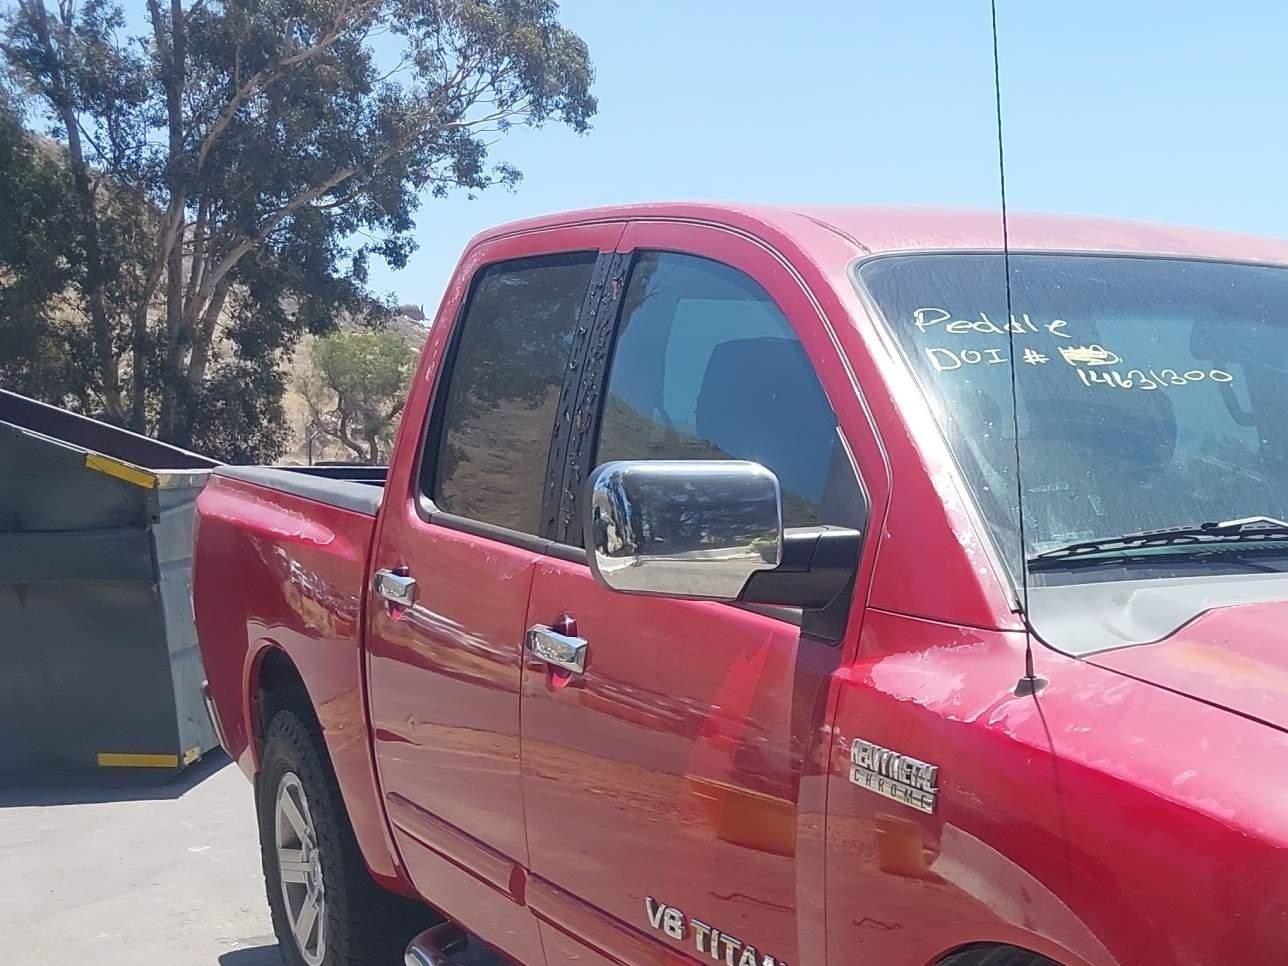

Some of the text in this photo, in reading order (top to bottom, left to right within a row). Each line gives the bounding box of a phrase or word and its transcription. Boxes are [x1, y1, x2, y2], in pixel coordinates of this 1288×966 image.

[913, 307, 1072, 338] Peddle
[925, 346, 1009, 371] DOI
[645, 896, 687, 941] V8
